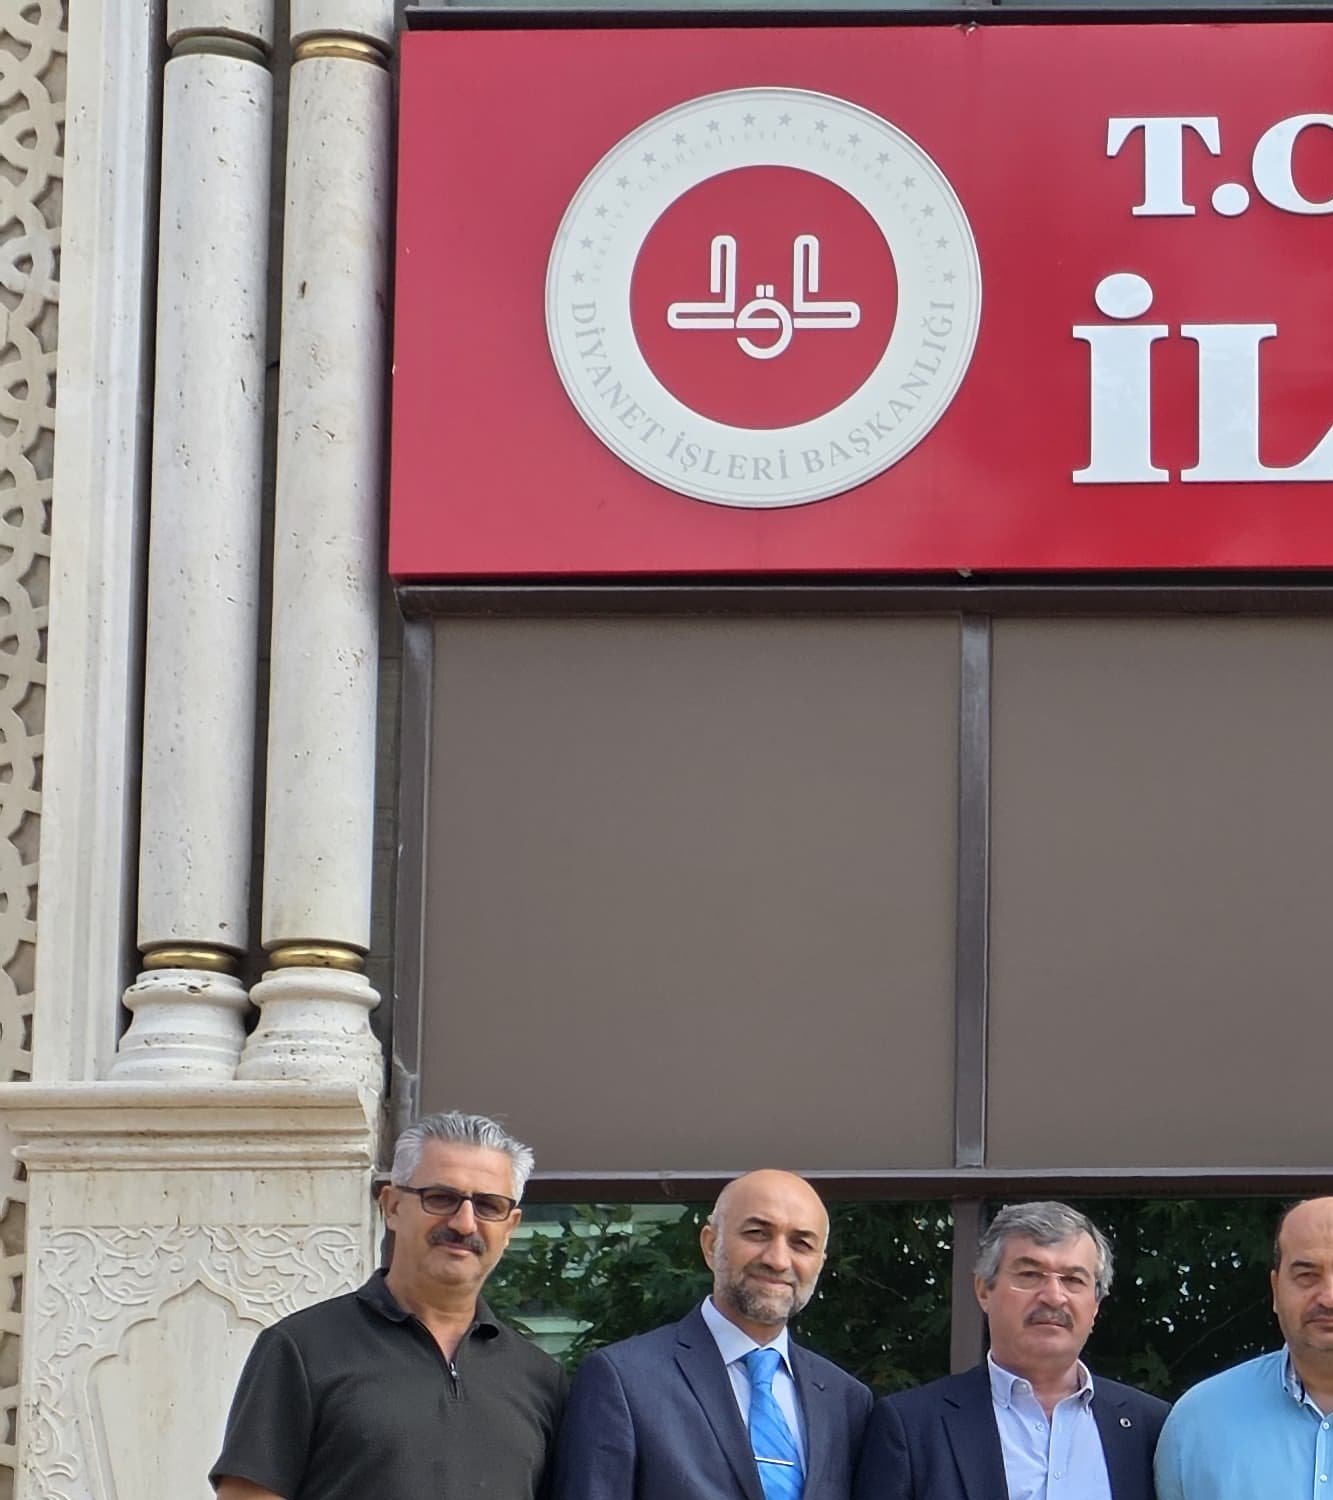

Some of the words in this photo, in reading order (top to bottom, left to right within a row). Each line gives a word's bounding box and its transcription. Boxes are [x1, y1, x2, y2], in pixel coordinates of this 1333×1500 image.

[571, 301, 664, 444] DİYANET
[666, 431, 791, 481] İŞLERİ
[801, 301, 955, 474] BAŞKANLIĞI
